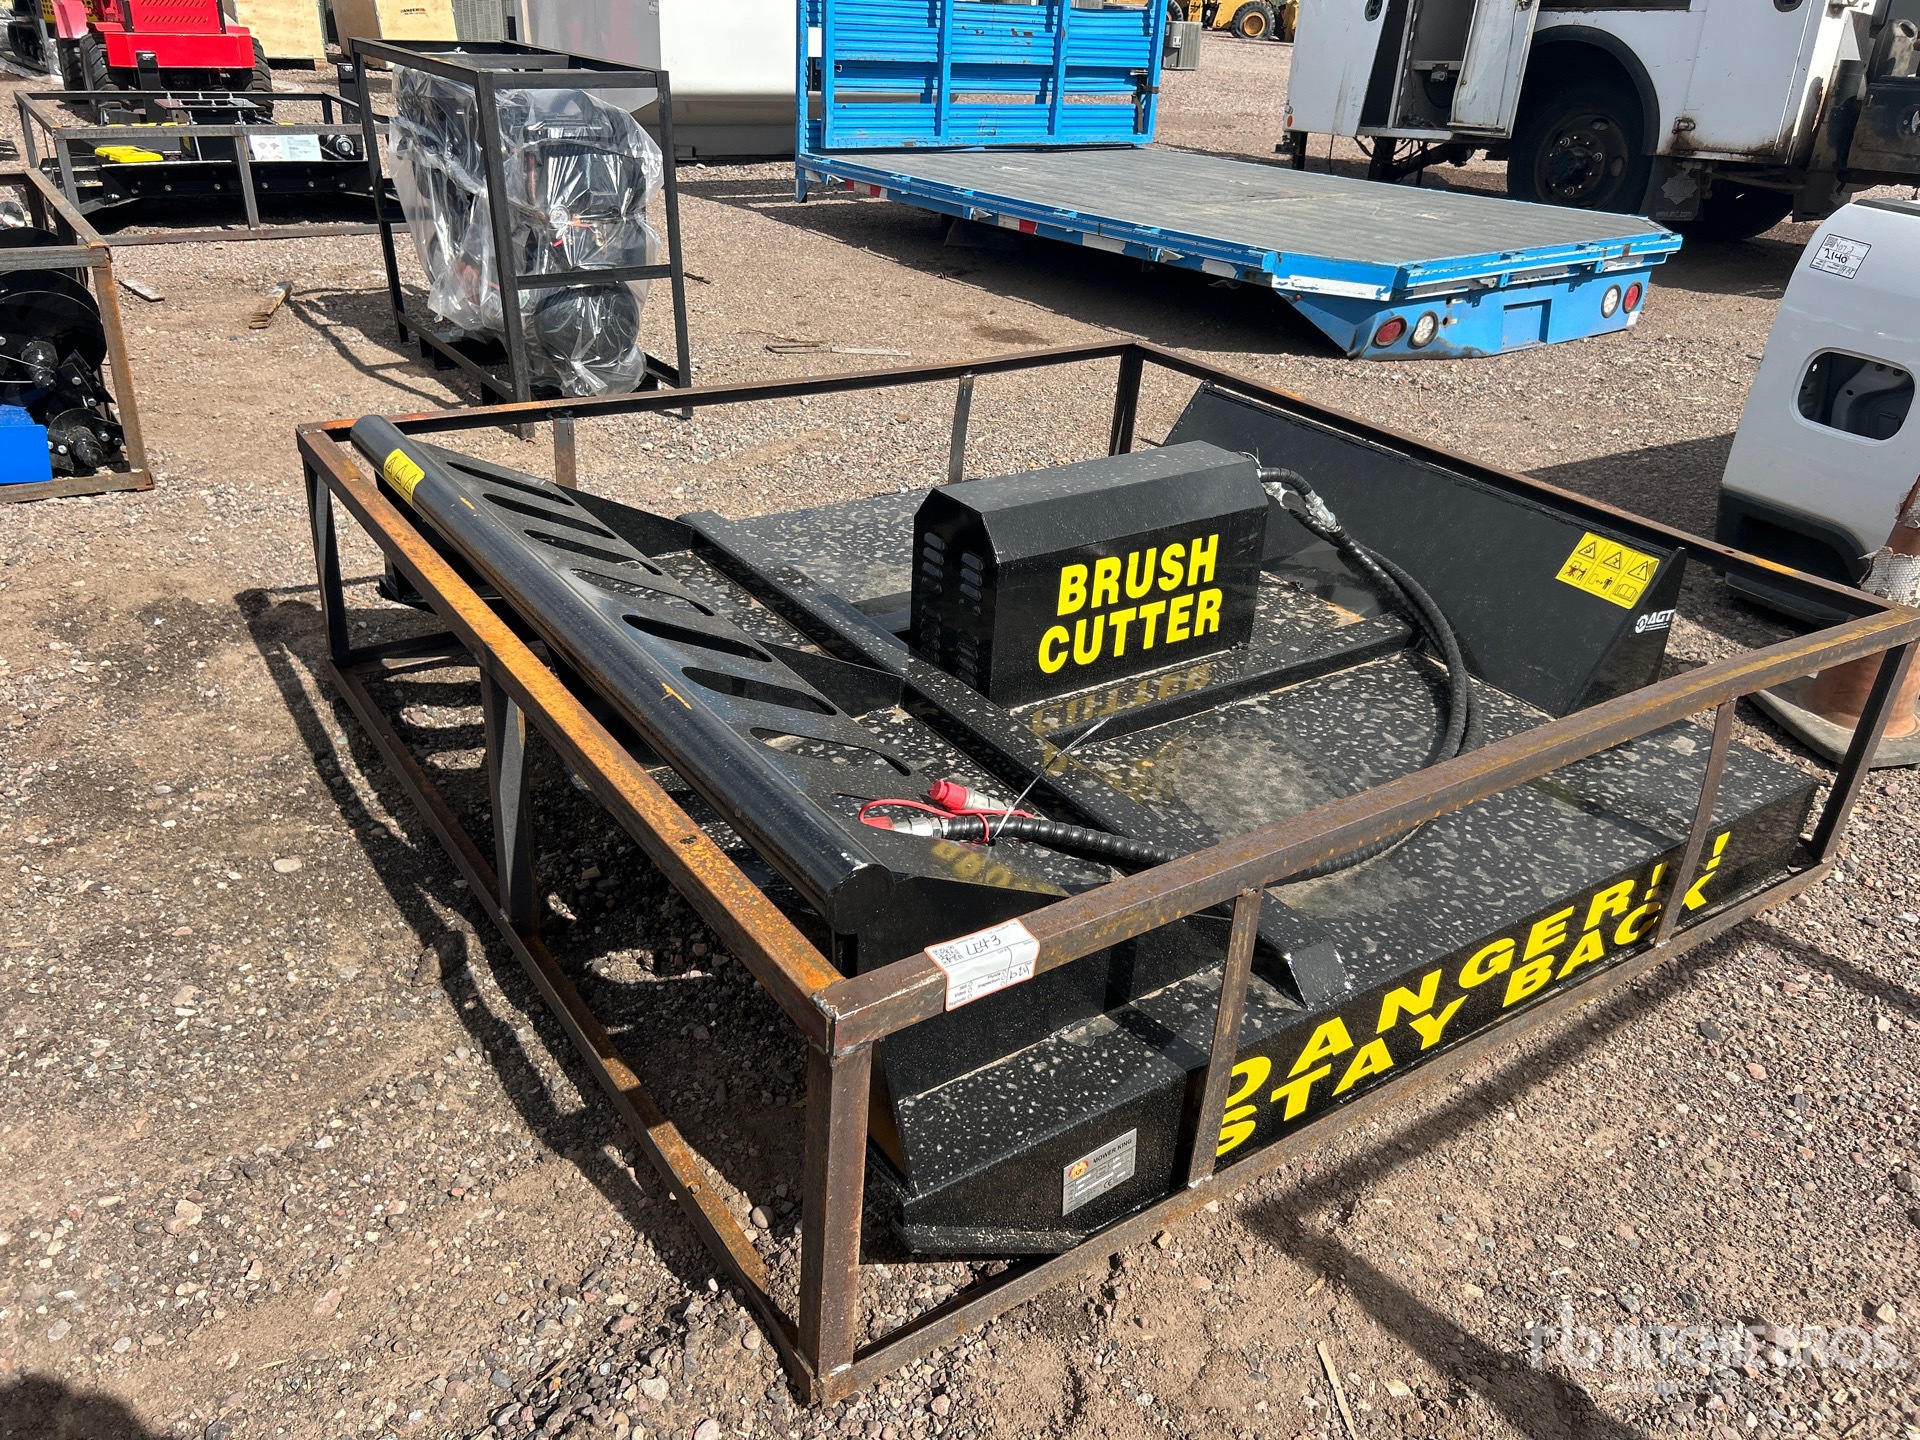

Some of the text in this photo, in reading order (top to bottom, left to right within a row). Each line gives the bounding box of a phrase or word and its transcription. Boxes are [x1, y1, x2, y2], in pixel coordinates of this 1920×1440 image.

[1824, 247, 1848, 264] 2140
[1057, 533, 1219, 616] BRUSH
[1038, 588, 1223, 674] CUTTER
[1646, 609, 1676, 625] AGT
[1215, 870, 1717, 1158] STAY BACK
[1092, 1138, 1132, 1164] MOWER KING
